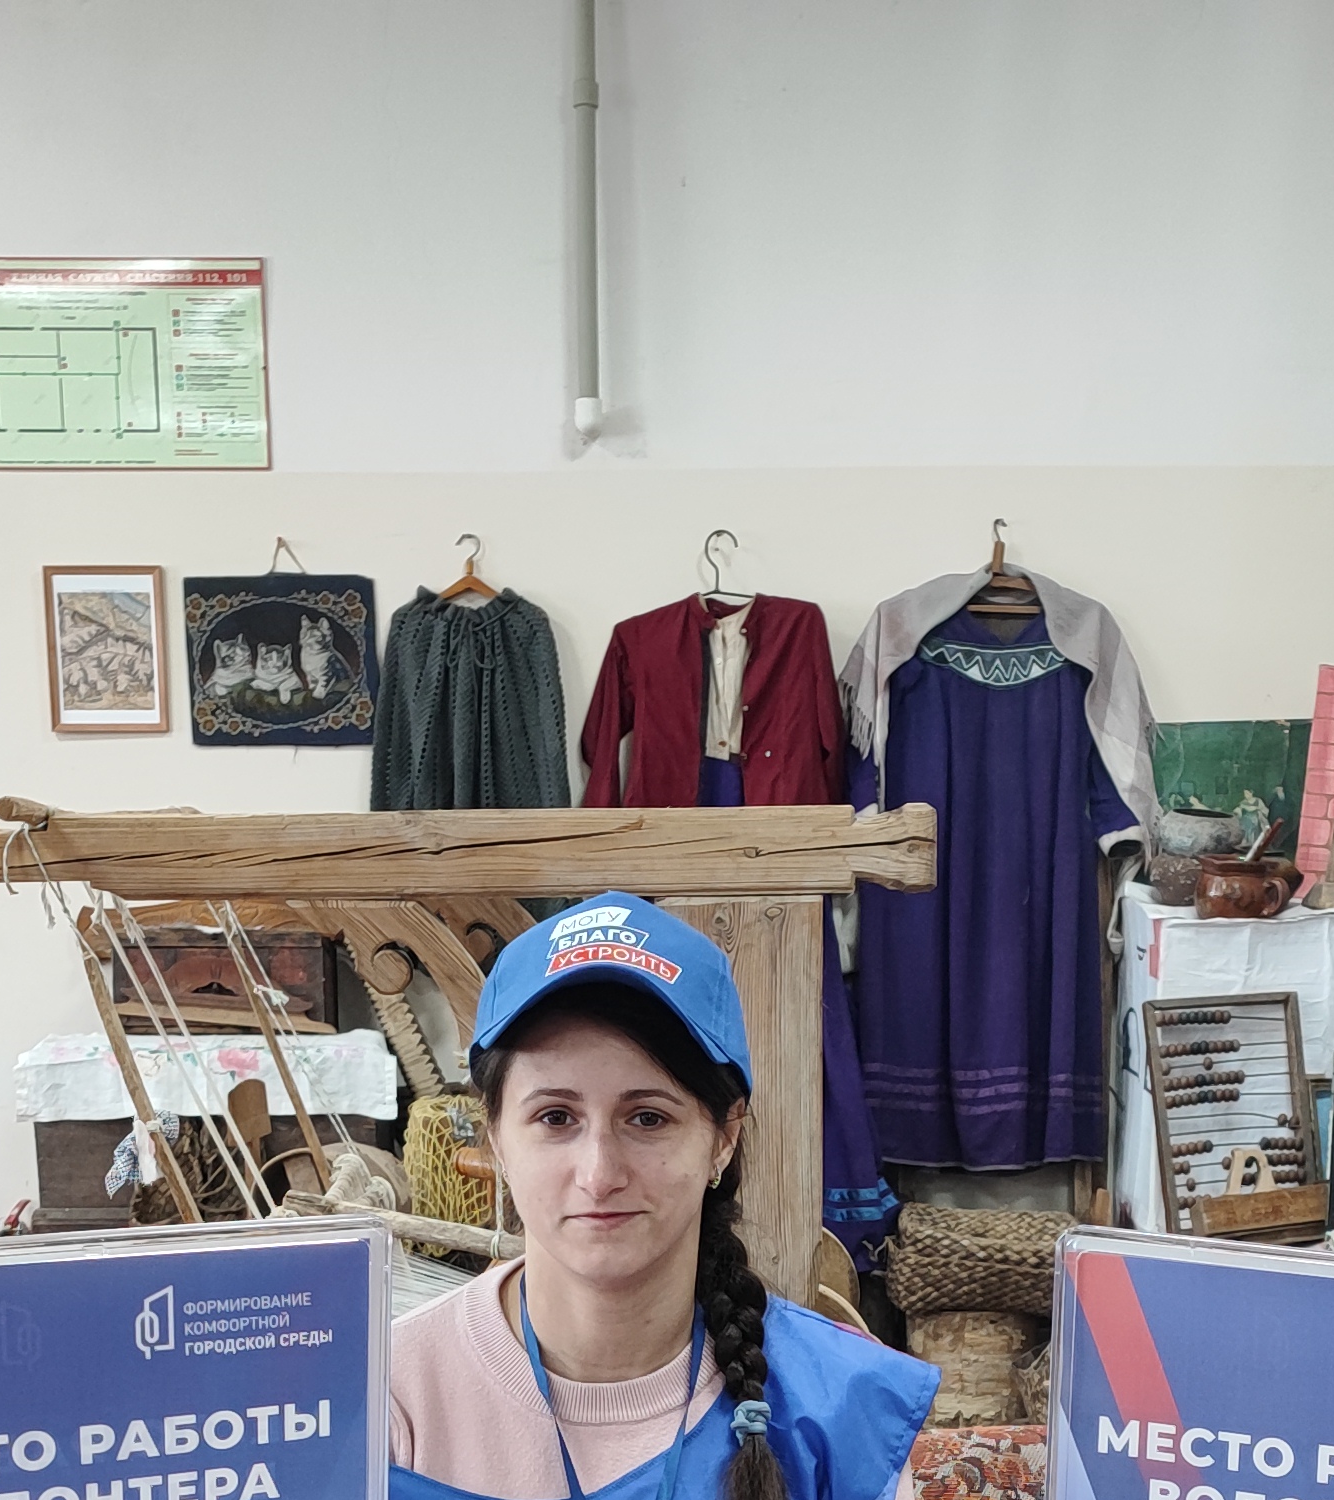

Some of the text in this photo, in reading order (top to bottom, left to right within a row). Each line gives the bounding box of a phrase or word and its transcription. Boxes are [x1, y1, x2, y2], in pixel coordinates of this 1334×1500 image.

[561, 912, 621, 933] МОГУ
[559, 929, 636, 950] БЛАГО
[558, 946, 671, 978] УСТРОИТЬ
[183, 1292, 312, 1316] ФОРМИРОВАНИЕ
[184, 1311, 290, 1336] КОМФОРТНОЙ
[184, 1328, 333, 1355] ГОРОДСКОЙ СРЕДЫ
[79, 1399, 331, 1465] РАБОТЫ
[1097, 1415, 1294, 1478] МЕСТО
